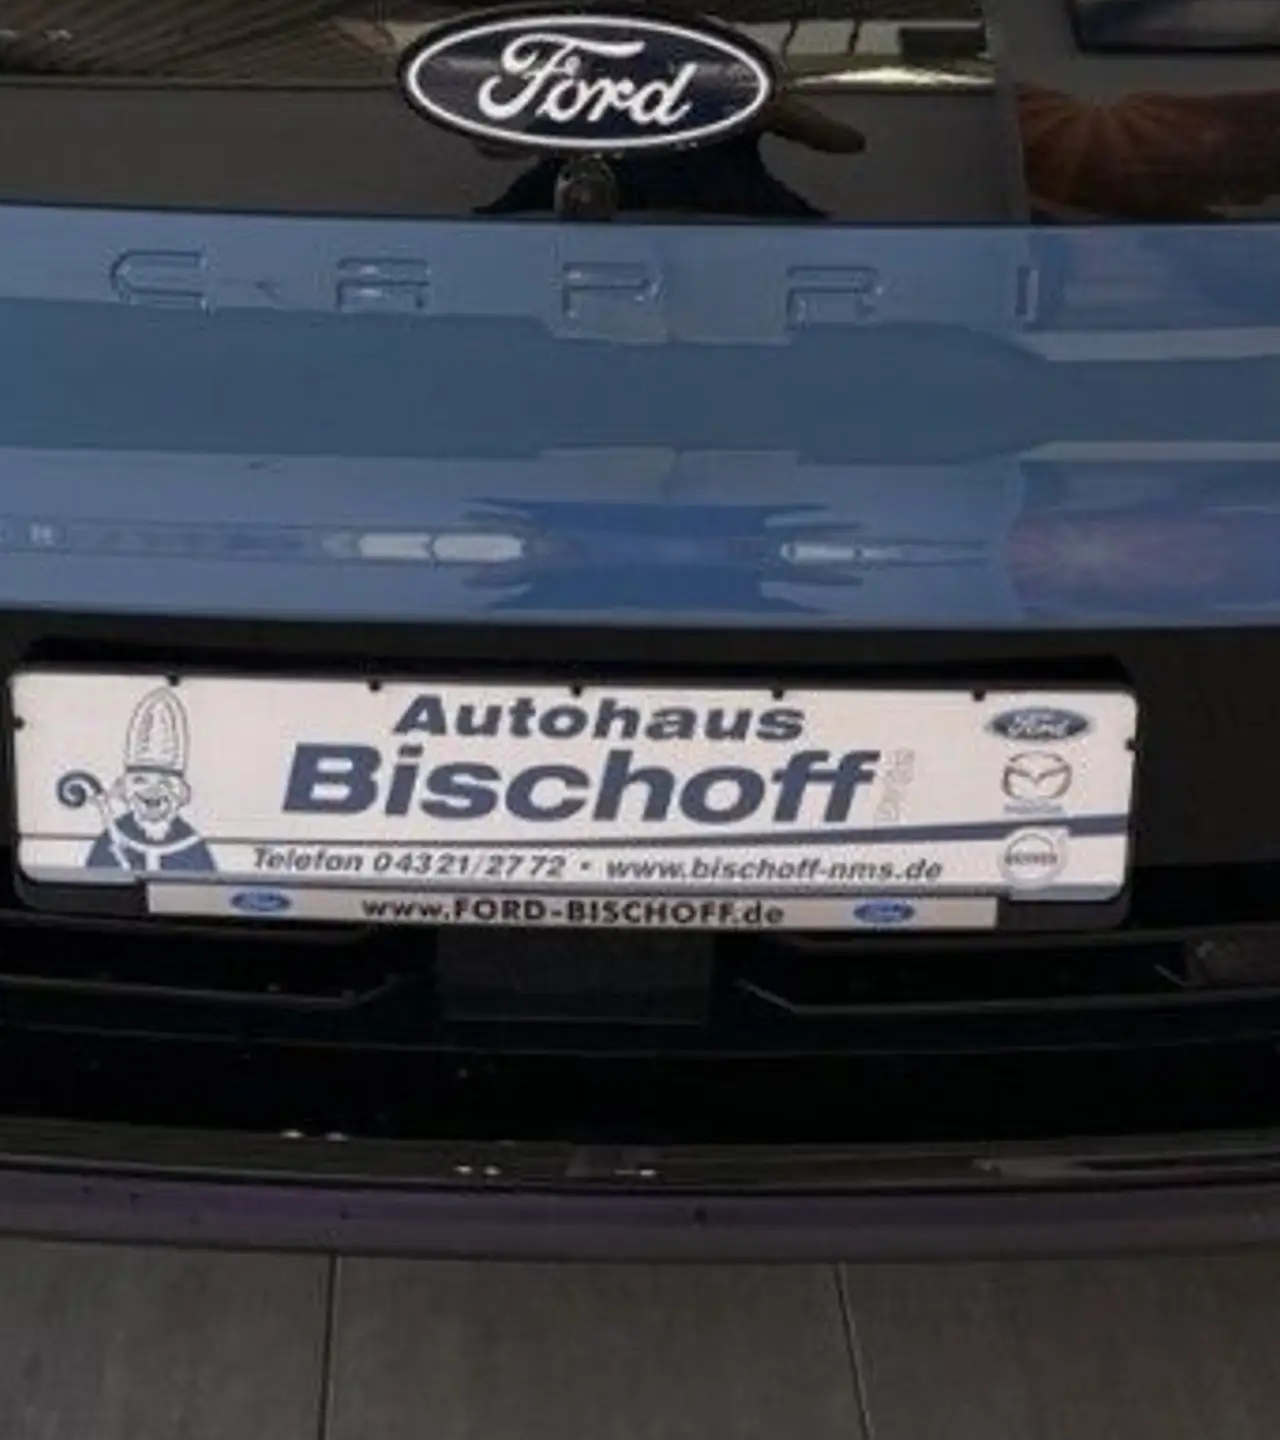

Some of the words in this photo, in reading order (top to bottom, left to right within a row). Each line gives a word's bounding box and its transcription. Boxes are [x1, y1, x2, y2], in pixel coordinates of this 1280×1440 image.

[478, 31, 692, 127] Ford
[393, 693, 806, 742] Autohaus
[282, 742, 881, 824] Bischoff
[254, 847, 364, 872] Telefon
[606, 857, 943, 881] www.bischoff-nms.de
[361, 896, 785, 925] www.FORD-BISCHOFF.de
